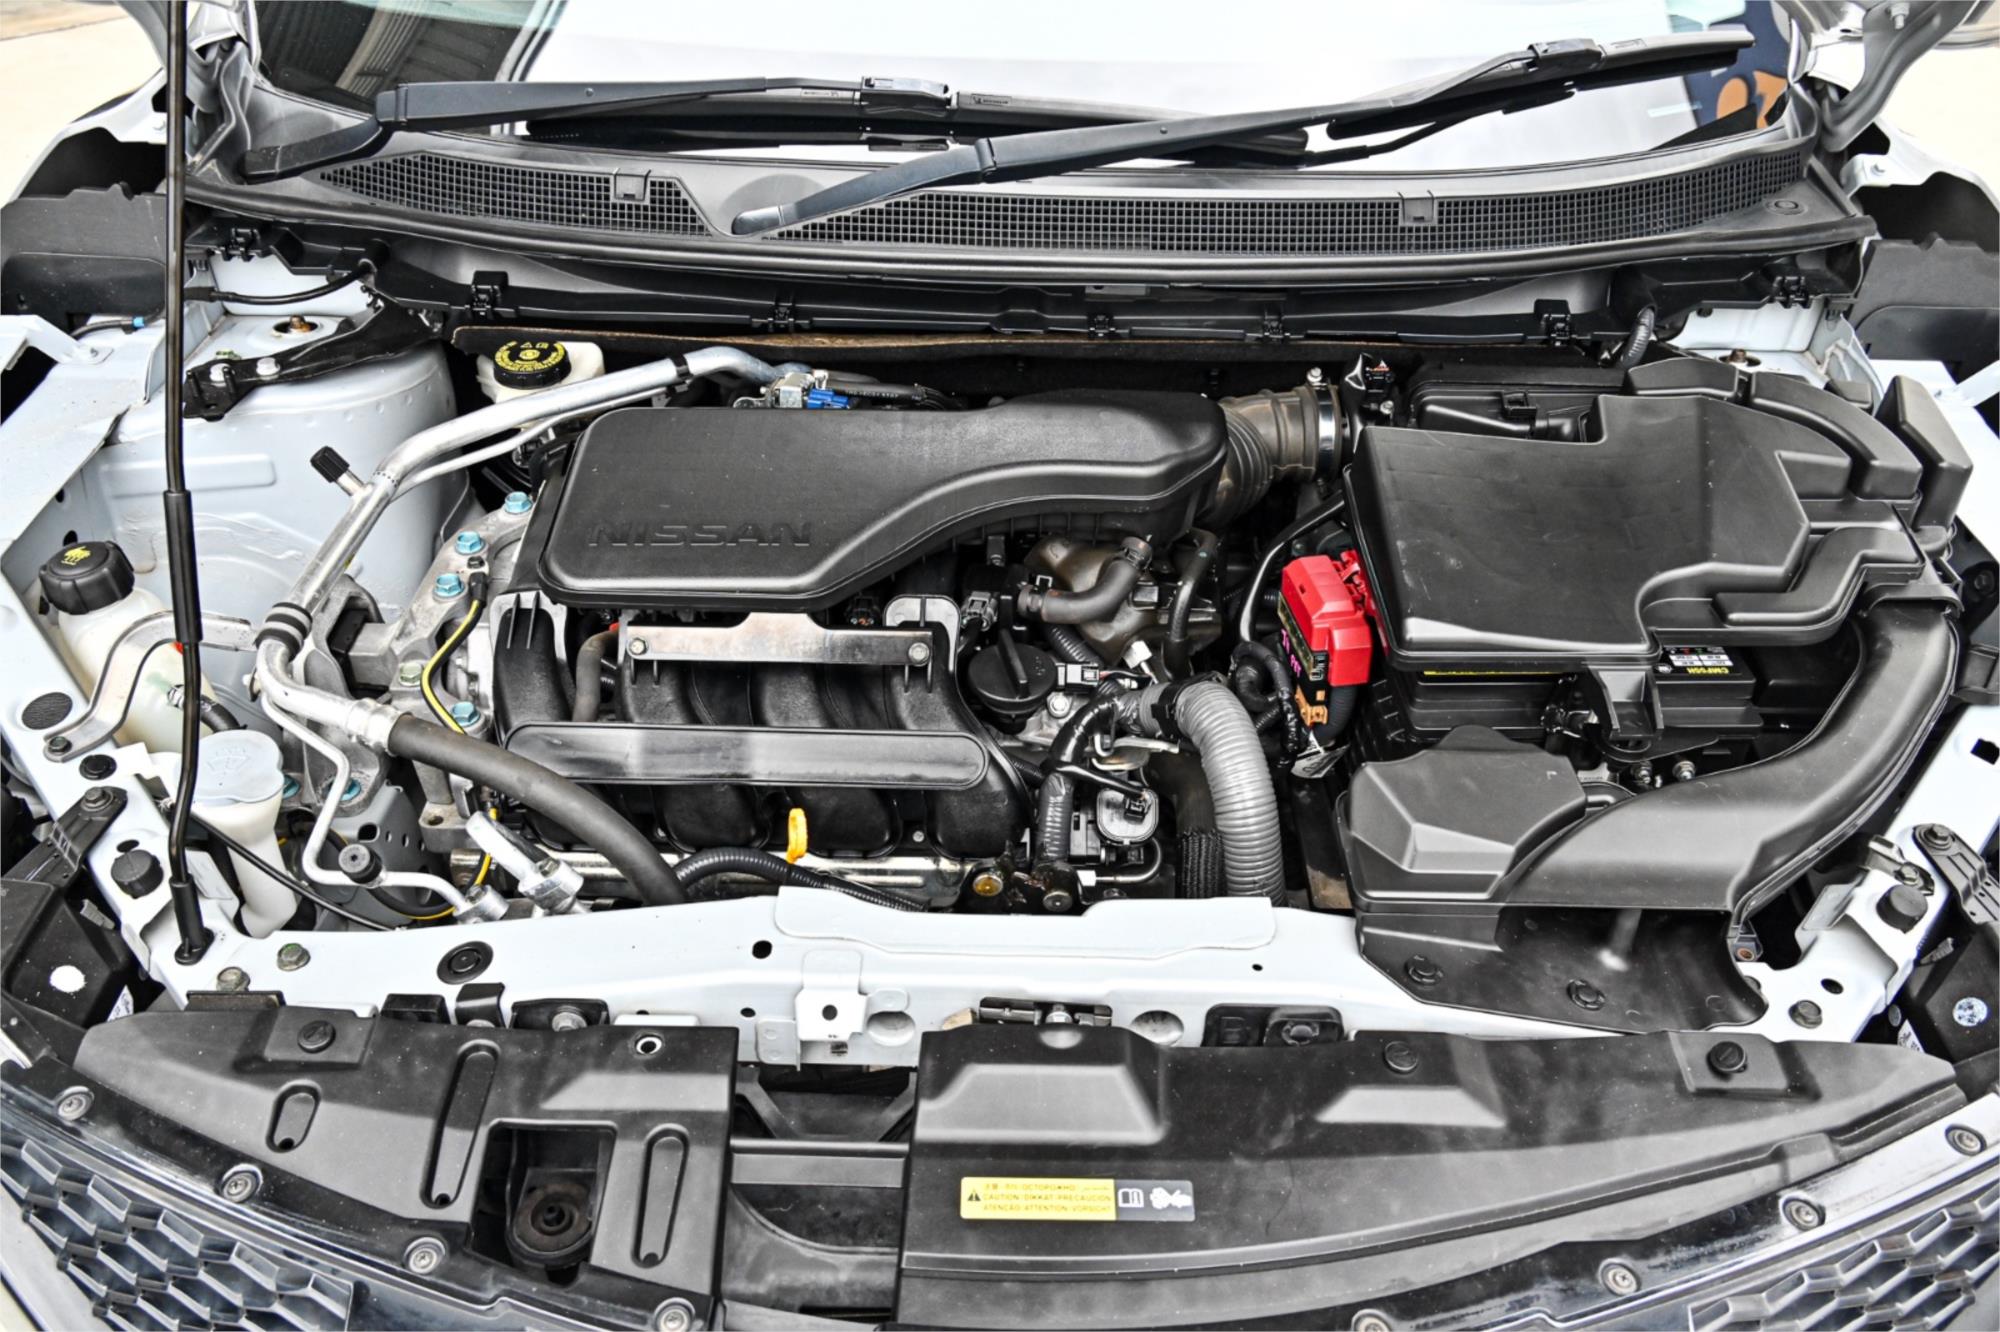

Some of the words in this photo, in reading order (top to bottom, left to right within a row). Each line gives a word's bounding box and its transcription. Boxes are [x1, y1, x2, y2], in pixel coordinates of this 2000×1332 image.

[588, 521, 812, 547] NISSAN
[982, 1193, 1020, 1201] CAUTION
[1024, 1204, 1068, 1212] ATTENTION
